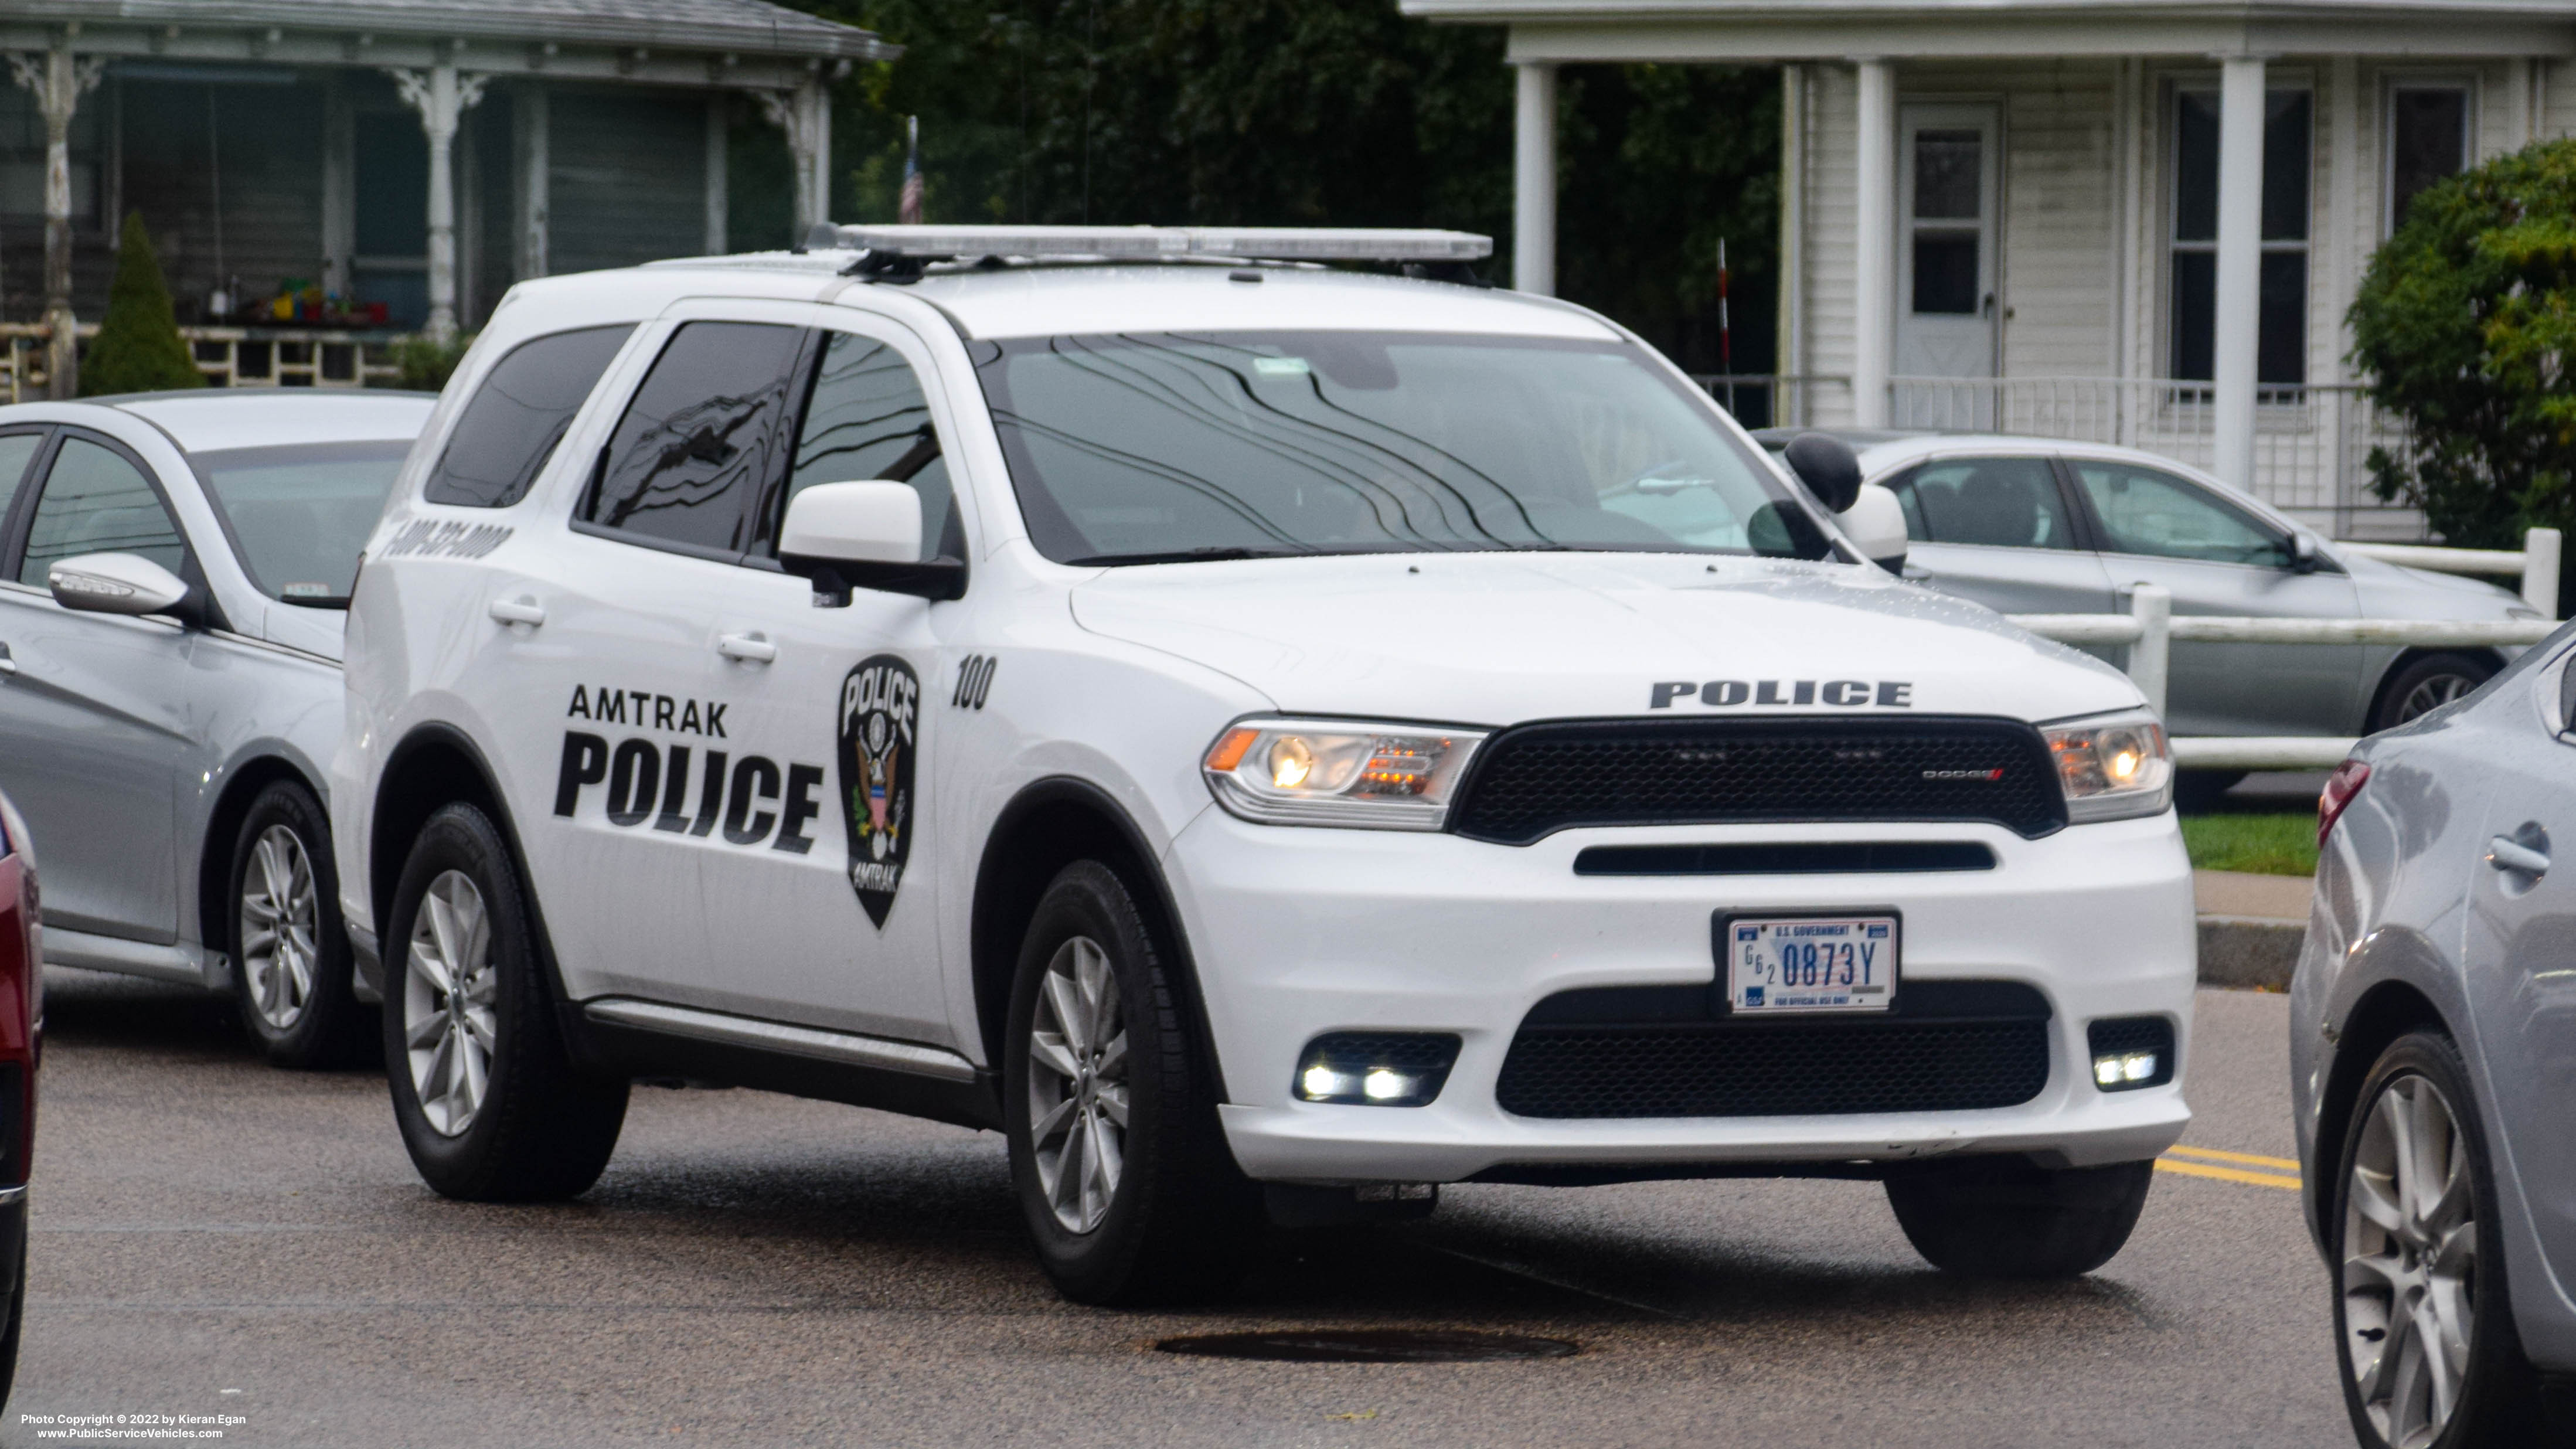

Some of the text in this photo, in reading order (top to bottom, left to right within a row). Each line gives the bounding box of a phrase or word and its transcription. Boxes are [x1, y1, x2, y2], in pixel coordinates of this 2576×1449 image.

[952, 654, 996, 710] 100
[1649, 681, 1913, 708] POLICE
[567, 683, 728, 739] AMTRAK
[843, 666, 916, 746] POLICE
[553, 730, 824, 855] POLICE
[1922, 770, 1993, 779] DODGE
[853, 862, 896, 893] AMTRAK
[1794, 925, 1849, 936] GOVERNMENT
[1784, 941, 1875, 986] 0873Y
